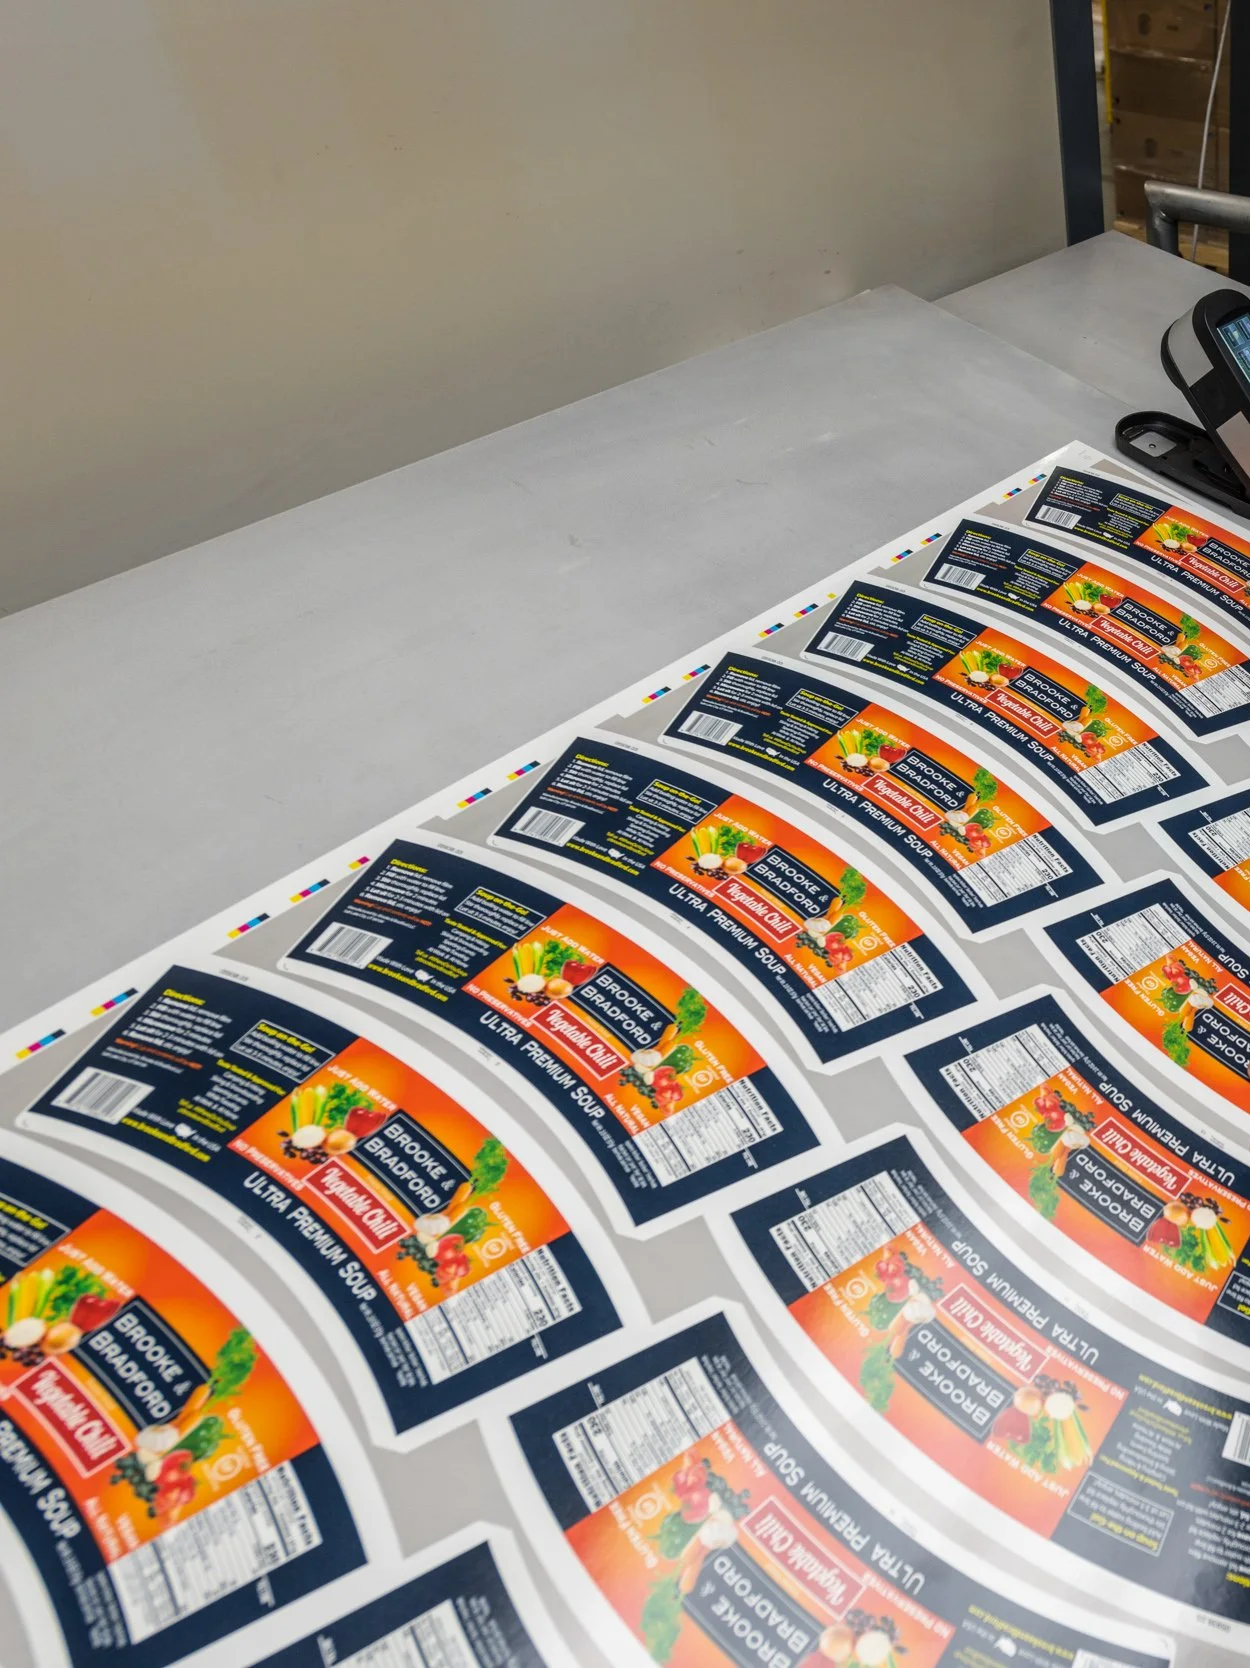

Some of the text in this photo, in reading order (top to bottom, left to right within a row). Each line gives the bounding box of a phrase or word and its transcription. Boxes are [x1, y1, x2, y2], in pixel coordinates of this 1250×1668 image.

[1151, 555, 1243, 611] ULTRA PREMIUM SOUP
[1188, 557, 1241, 589] Vegetable Chili
[1208, 542, 1250, 568] BROOKE
[1100, 620, 1156, 655] Vegetable Chili
[1115, 608, 1170, 645] BRADFORD
[1122, 603, 1167, 631] BROOKE
[1059, 619, 1156, 681] ULTRA PREMIUM SOUP
[998, 693, 1055, 732] Vegetable Chili
[1015, 679, 1074, 720] BRADFORD
[1023, 673, 1078, 711] BROOKE &
[950, 693, 1055, 763] ULTRA PREMIUM SOUP
[873, 779, 935, 824] Vegetable Chili
[896, 763, 959, 808] BRADFORD
[907, 756, 965, 799] BROOKE &
[822, 778, 934, 860] ULTRA PREMIUM SOUP
[728, 882, 794, 935] Vegetable Chili
[754, 864, 821, 915] BRADFORD
[766, 854, 829, 904] BROOKE &
[668, 884, 787, 977] ULTRA PREMIUM SOUP
[1218, 954, 1250, 978] SOUP
[580, 985, 652, 1047] BRADFORD
[595, 974, 662, 1031] BROOKE &
[1196, 1026, 1207, 1035] &
[479, 1011, 605, 1121] ULTRA PREMIUM SOUP
[545, 1008, 616, 1071] Vegetable Chili
[939, 1068, 985, 1122] Nutrition Facts
[1057, 1073, 1078, 1095] VEGAN
[1063, 1066, 1104, 1105] ALL NATURAL
[383, 1123, 457, 1192] BROOKE &
[991, 1115, 1033, 1160] GLUTEN FREE
[1099, 1082, 1235, 1186] ULTRA PREMIUM SOUP
[1102, 1125, 1178, 1191] Vegetable Chili
[321, 1168, 398, 1240] Vegetable Chili
[364, 1136, 441, 1210] BRADFORD
[1068, 1169, 1145, 1232] BROOKE &
[1076, 1155, 1156, 1219] BRADFORD
[1188, 1169, 1247, 1209] PRESERVATIVES
[243, 1171, 377, 1302] ULTRA PREMIUM SOUP
[1142, 1244, 1218, 1292] JUST ADD WATER
[951, 1240, 1099, 1365] ULTRA PREMIUM SOUP
[113, 1312, 193, 1396] BROOKE &
[949, 1297, 1034, 1373] Vegetable Chili
[88, 1330, 172, 1419] BRADFORD
[908, 1349, 992, 1425] BROOKE &
[918, 1330, 1004, 1408] BRADFORD
[31, 1372, 118, 1461] Vegetable Chili
[36, 1487, 82, 1539] SOUP
[762, 1442, 927, 1595] ULTRA PREMIUM SOUP
[753, 1514, 843, 1606] Vegetable Chili
[701, 1580, 792, 1668] BROOKE &
[713, 1554, 809, 1655] BRADFORD
